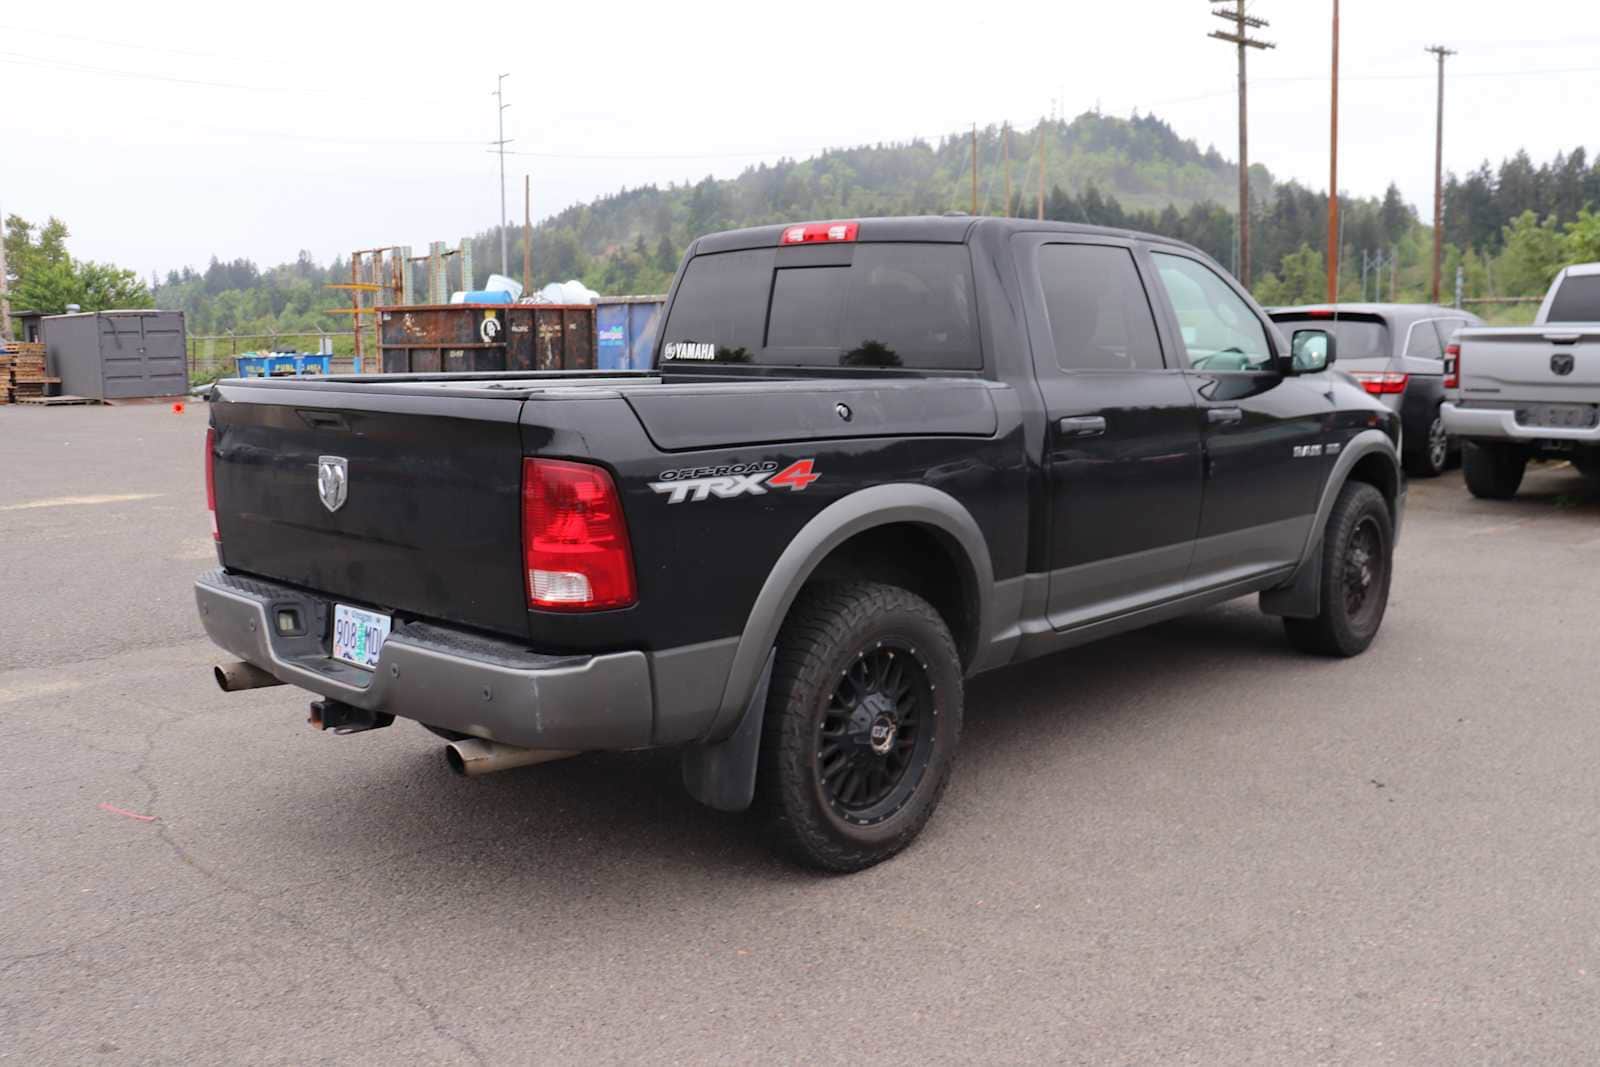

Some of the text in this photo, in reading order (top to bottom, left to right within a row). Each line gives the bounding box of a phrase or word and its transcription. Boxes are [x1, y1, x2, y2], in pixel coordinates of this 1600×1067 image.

[676, 343, 715, 360] YAMAHA
[660, 461, 778, 481] OFF-ROAD
[336, 619, 356, 648] 908
